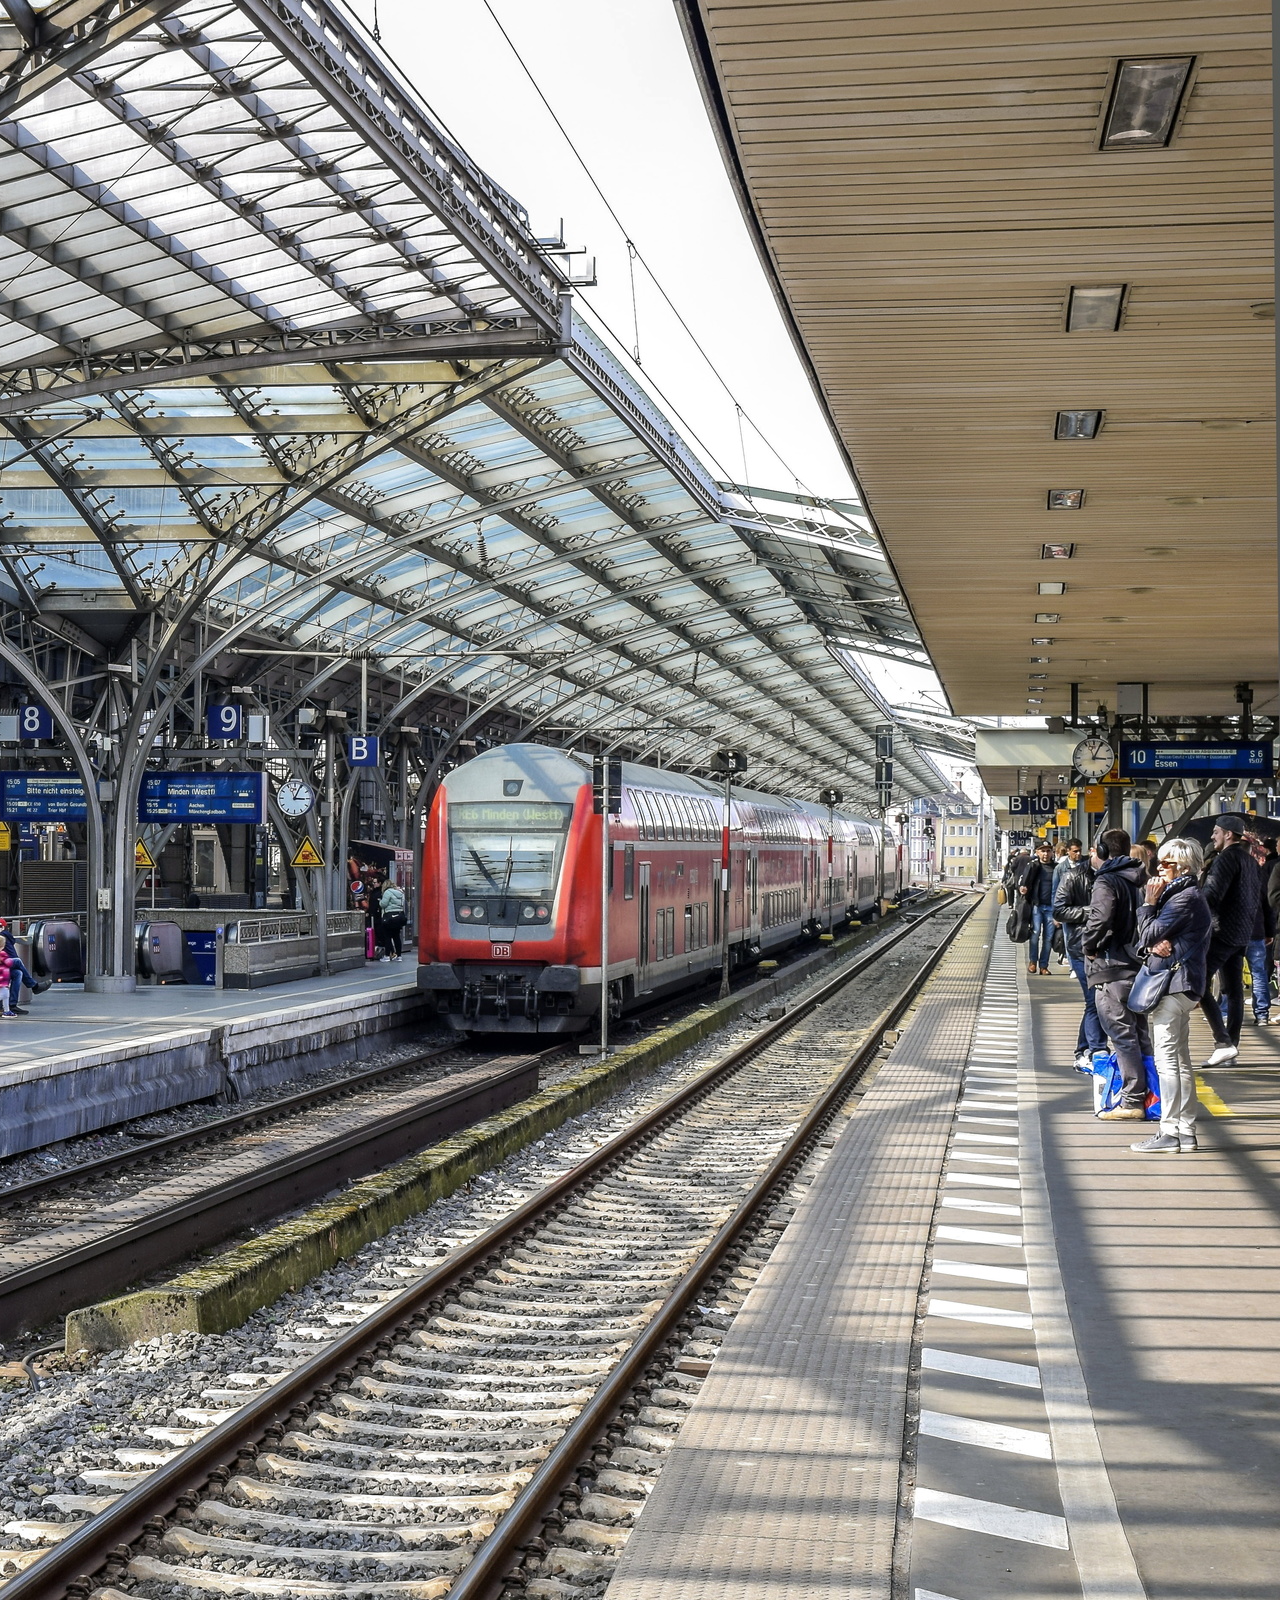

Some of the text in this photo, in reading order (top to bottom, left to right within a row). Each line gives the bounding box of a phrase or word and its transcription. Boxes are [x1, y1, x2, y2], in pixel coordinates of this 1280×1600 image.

[24, 707, 40, 731] 8
[220, 706, 237, 732] 9
[351, 737, 368, 760] B
[1250, 750, 1264, 758] S 6
[1130, 749, 1146, 764] 10
[167, 788, 216, 796] Minden (Westf)
[1011, 796, 1050, 811] B 10
[482, 808, 520, 821] Minden
[522, 807, 563, 821] (Westf)
[494, 946, 509, 956] DB
